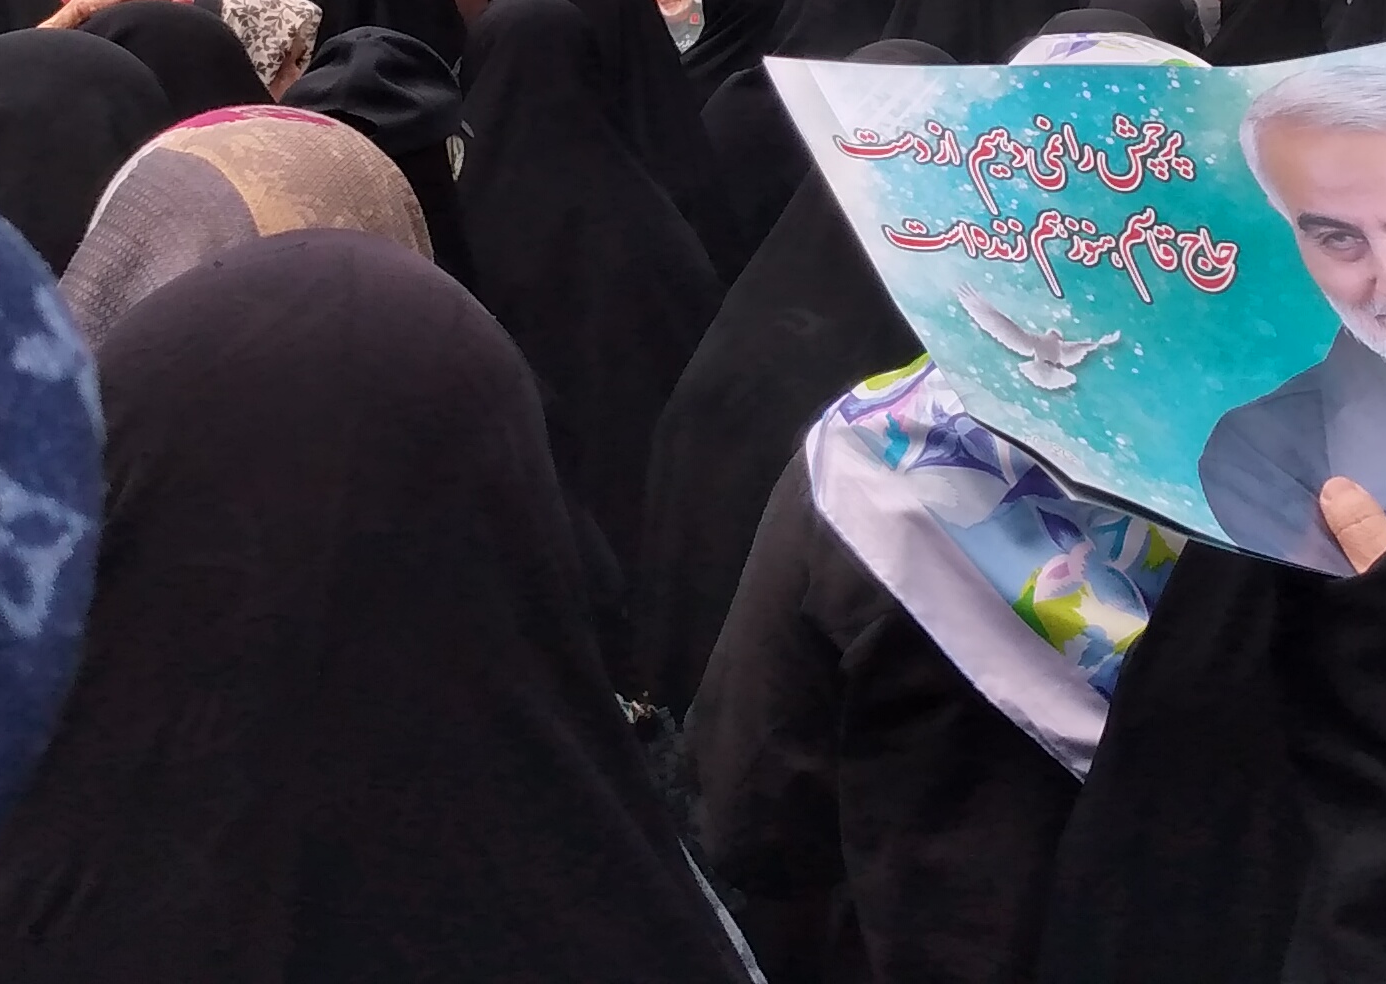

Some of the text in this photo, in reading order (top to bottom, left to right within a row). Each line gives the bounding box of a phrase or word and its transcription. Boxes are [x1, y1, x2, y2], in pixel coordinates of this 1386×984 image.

[833, 127, 932, 163] دست
[925, 119, 962, 167] از
[1095, 114, 1196, 193] پرچمش
[881, 217, 981, 259] است
[1118, 206, 1179, 305] قاسم
[1176, 227, 1239, 294] حاج
